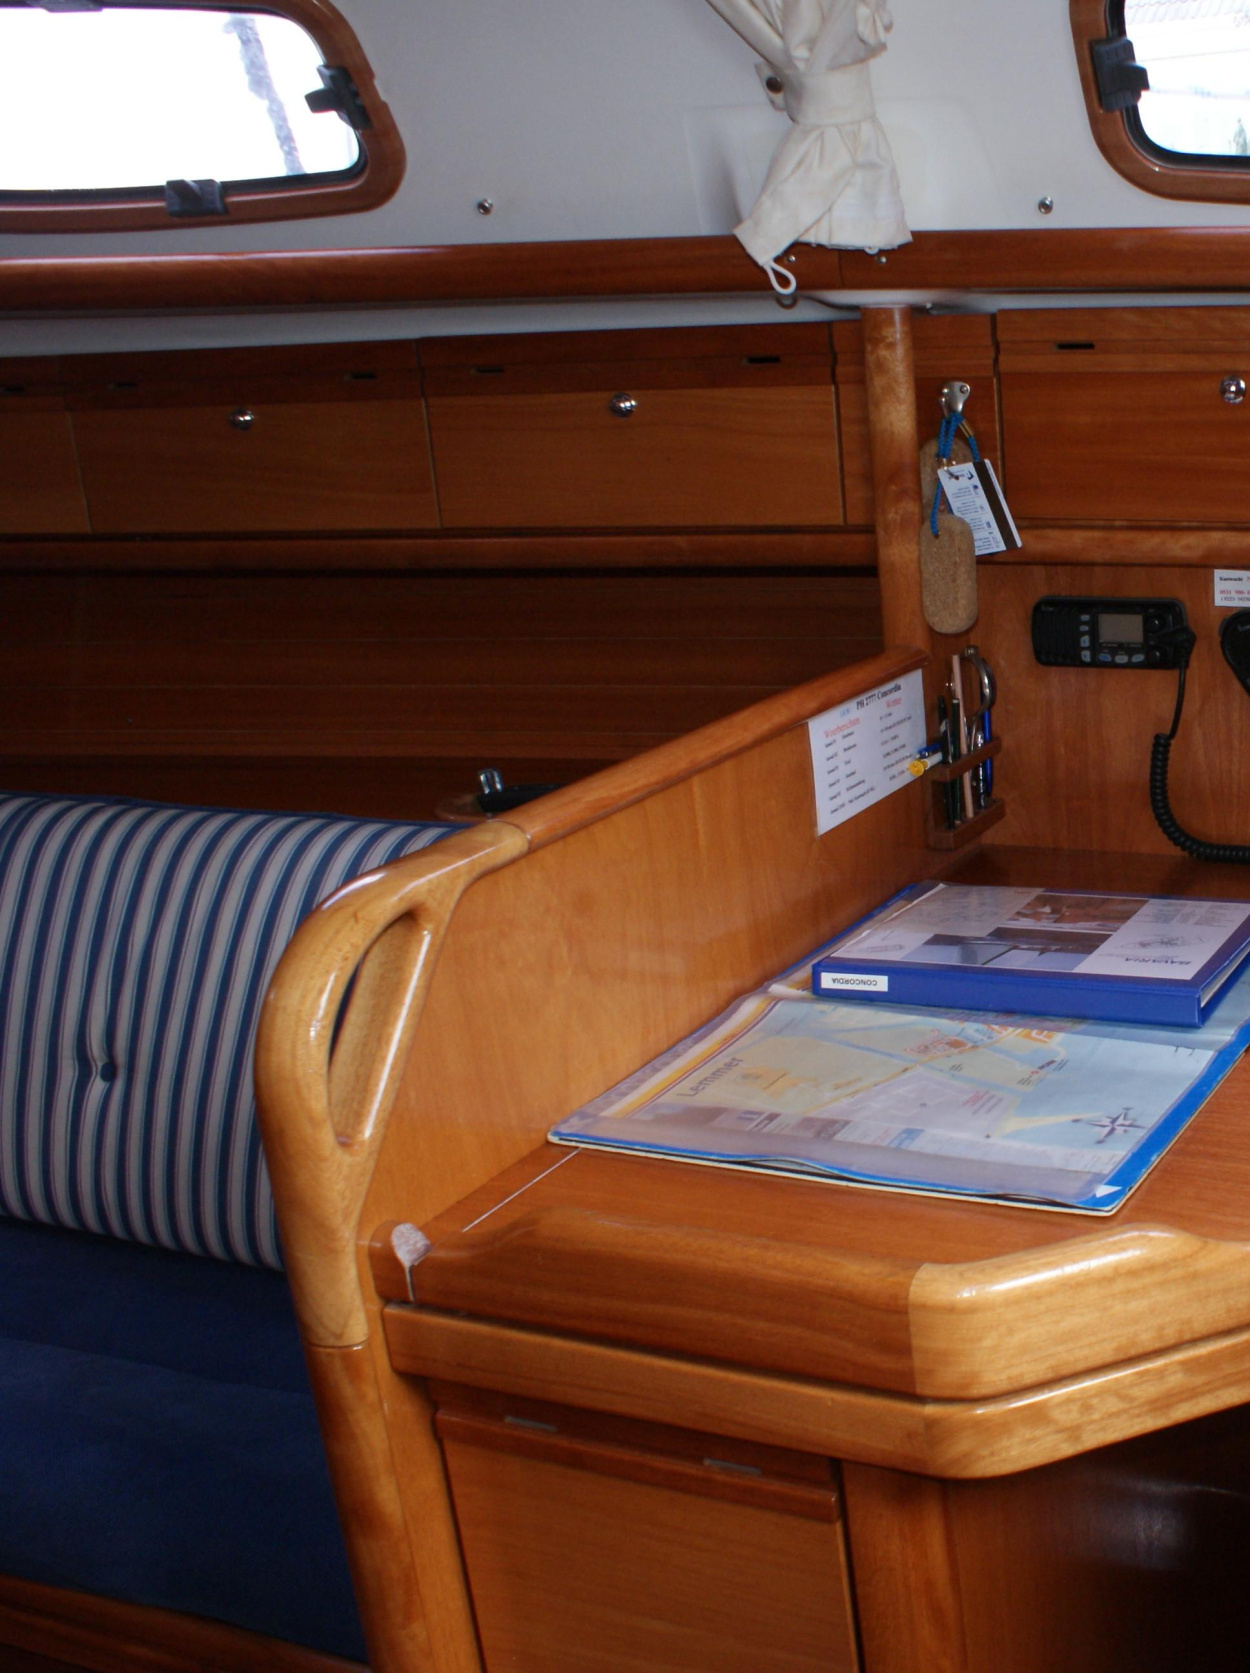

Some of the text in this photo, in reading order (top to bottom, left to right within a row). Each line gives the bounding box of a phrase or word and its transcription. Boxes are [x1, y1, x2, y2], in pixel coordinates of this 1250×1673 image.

[856, 699, 865, 710] PH
[877, 683, 902, 700] Concordia
[1124, 956, 1192, 966] BAVARIA
[831, 977, 878, 987] CONCORDIA
[676, 1056, 744, 1098] Lemmer
